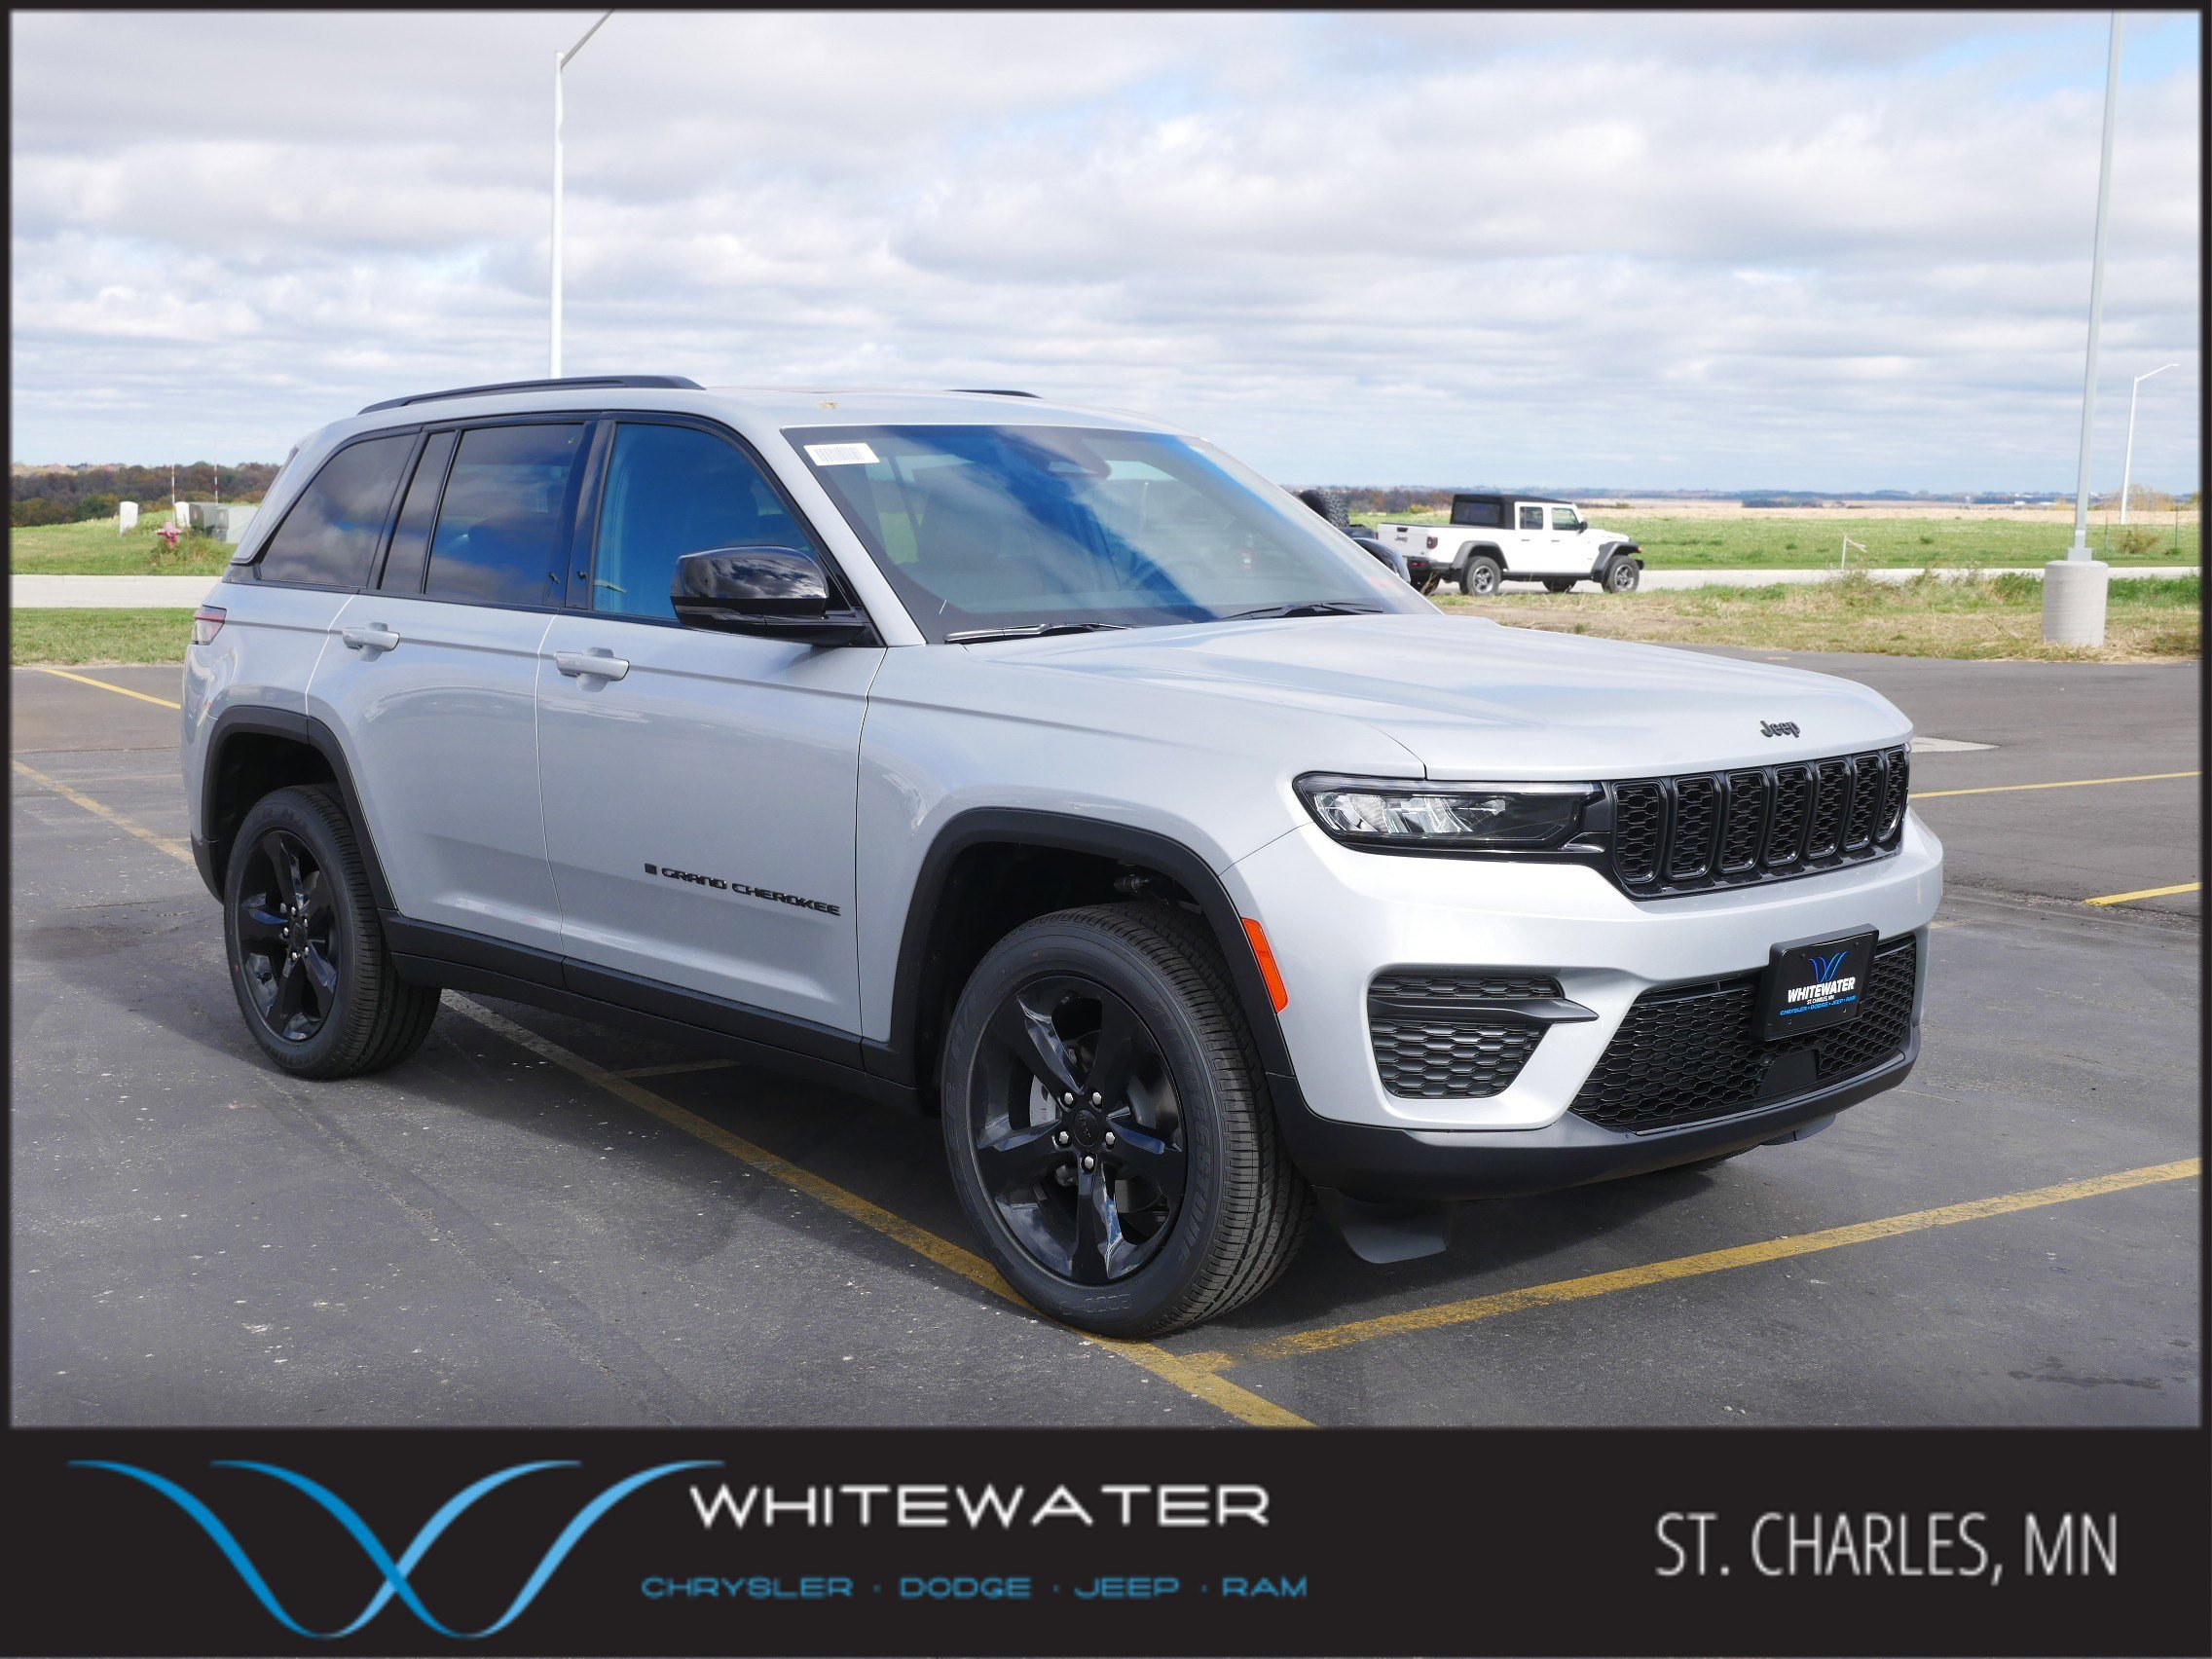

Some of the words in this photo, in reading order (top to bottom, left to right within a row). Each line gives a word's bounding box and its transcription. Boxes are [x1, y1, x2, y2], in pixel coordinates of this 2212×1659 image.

[1759, 720, 1800, 738] Jeep
[661, 867, 728, 890] GRAND
[731, 882, 841, 917] CHEROKEE
[1788, 977, 1856, 1003] WHITEWATER
[1780, 1006, 1808, 1015] CHRYSLER
[1810, 1001, 1829, 1010] DODGE
